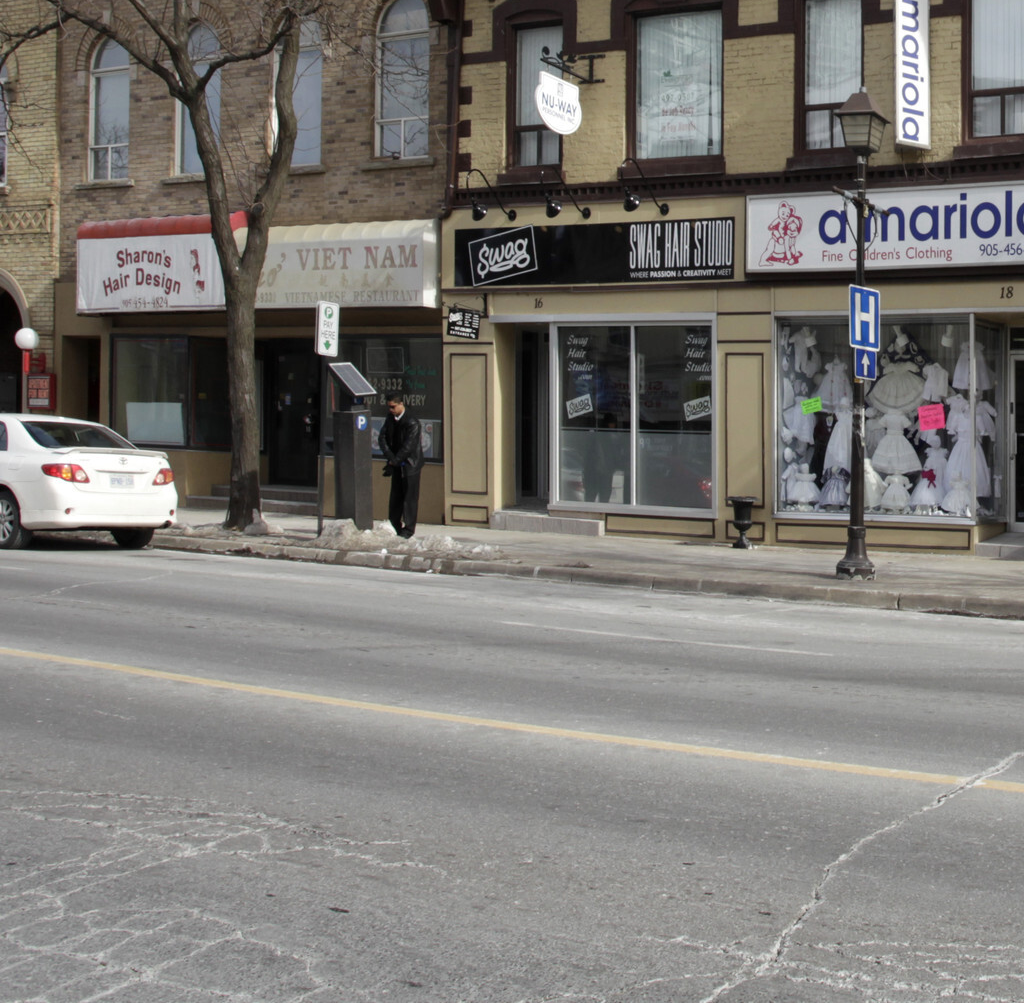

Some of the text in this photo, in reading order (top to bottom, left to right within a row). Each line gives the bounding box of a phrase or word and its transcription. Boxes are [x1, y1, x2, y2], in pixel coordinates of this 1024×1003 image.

[541, 91, 578, 117] NU-WAY
[629, 219, 733, 270] SWAG HAIR STUDIO
[116, 247, 172, 269] Sharon's
[296, 246, 352, 271] VIET
[363, 244, 419, 269] NAM
[821, 245, 953, 263] Fine Cildren's Clothing
[630, 271, 649, 279] WHERE
[650, 269, 676, 278] PASSION
[683, 269, 716, 278] CREATIVITY
[716, 268, 732, 276] MEET
[103, 267, 181, 297] Hair Design
[285, 289, 420, 304] VIETNAMESE RESTAURANT
[999, 286, 1014, 299] 18
[133, 297, 169, 309] 454-4824
[534, 298, 544, 309] 16
[323, 320, 334, 328] PAY
[854, 292, 876, 344] H
[321, 330, 336, 340] HERE
[567, 335, 589, 346] Swag
[685, 335, 709, 346] Swag
[566, 348, 587, 358] Hair
[684, 348, 706, 358] Hair
[568, 361, 594, 372] Studio
